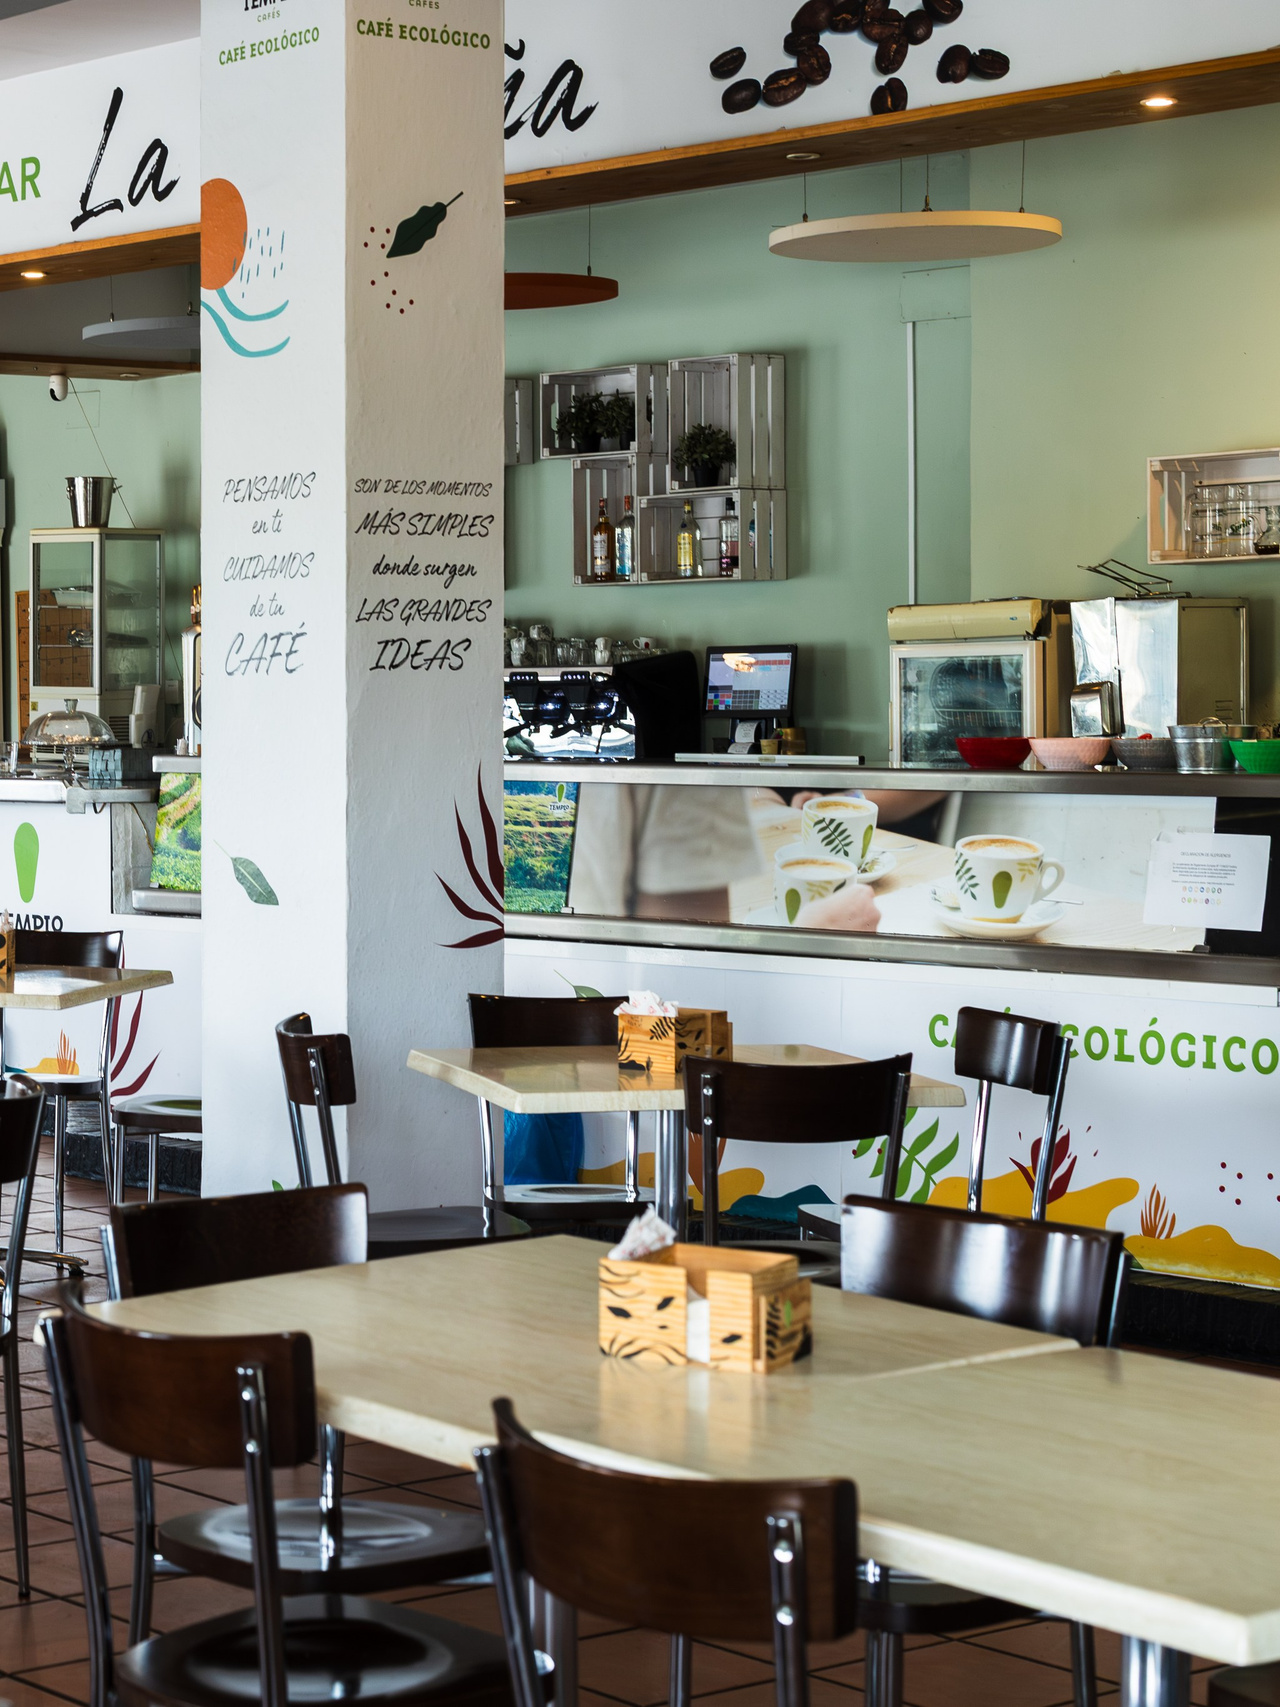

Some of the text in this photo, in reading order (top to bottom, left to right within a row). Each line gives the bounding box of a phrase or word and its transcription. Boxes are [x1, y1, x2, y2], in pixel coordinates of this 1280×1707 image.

[257, 7, 281, 23] CAFÉS
[219, 27, 320, 65] CAFÉ ECOLÓGICO
[357, 17, 490, 49] CAFÉ ECOLÓGICO
[70, 86, 181, 232] La
[222, 471, 316, 503] PENSAMOS
[354, 478, 493, 497] SON DE LOS MOMENTOS
[251, 508, 283, 534] en ti
[354, 507, 495, 538] MÁS SIMPLES
[222, 551, 315, 583] CUIDAMOS
[372, 554, 477, 590] donde surgen
[249, 592, 285, 617] de tu
[355, 597, 493, 627] LAS GRANDES
[225, 621, 308, 677] CAFÉ
[369, 637, 472, 671] IDEAS
[1060, 1016, 1280, 1075] COLÓGICO
